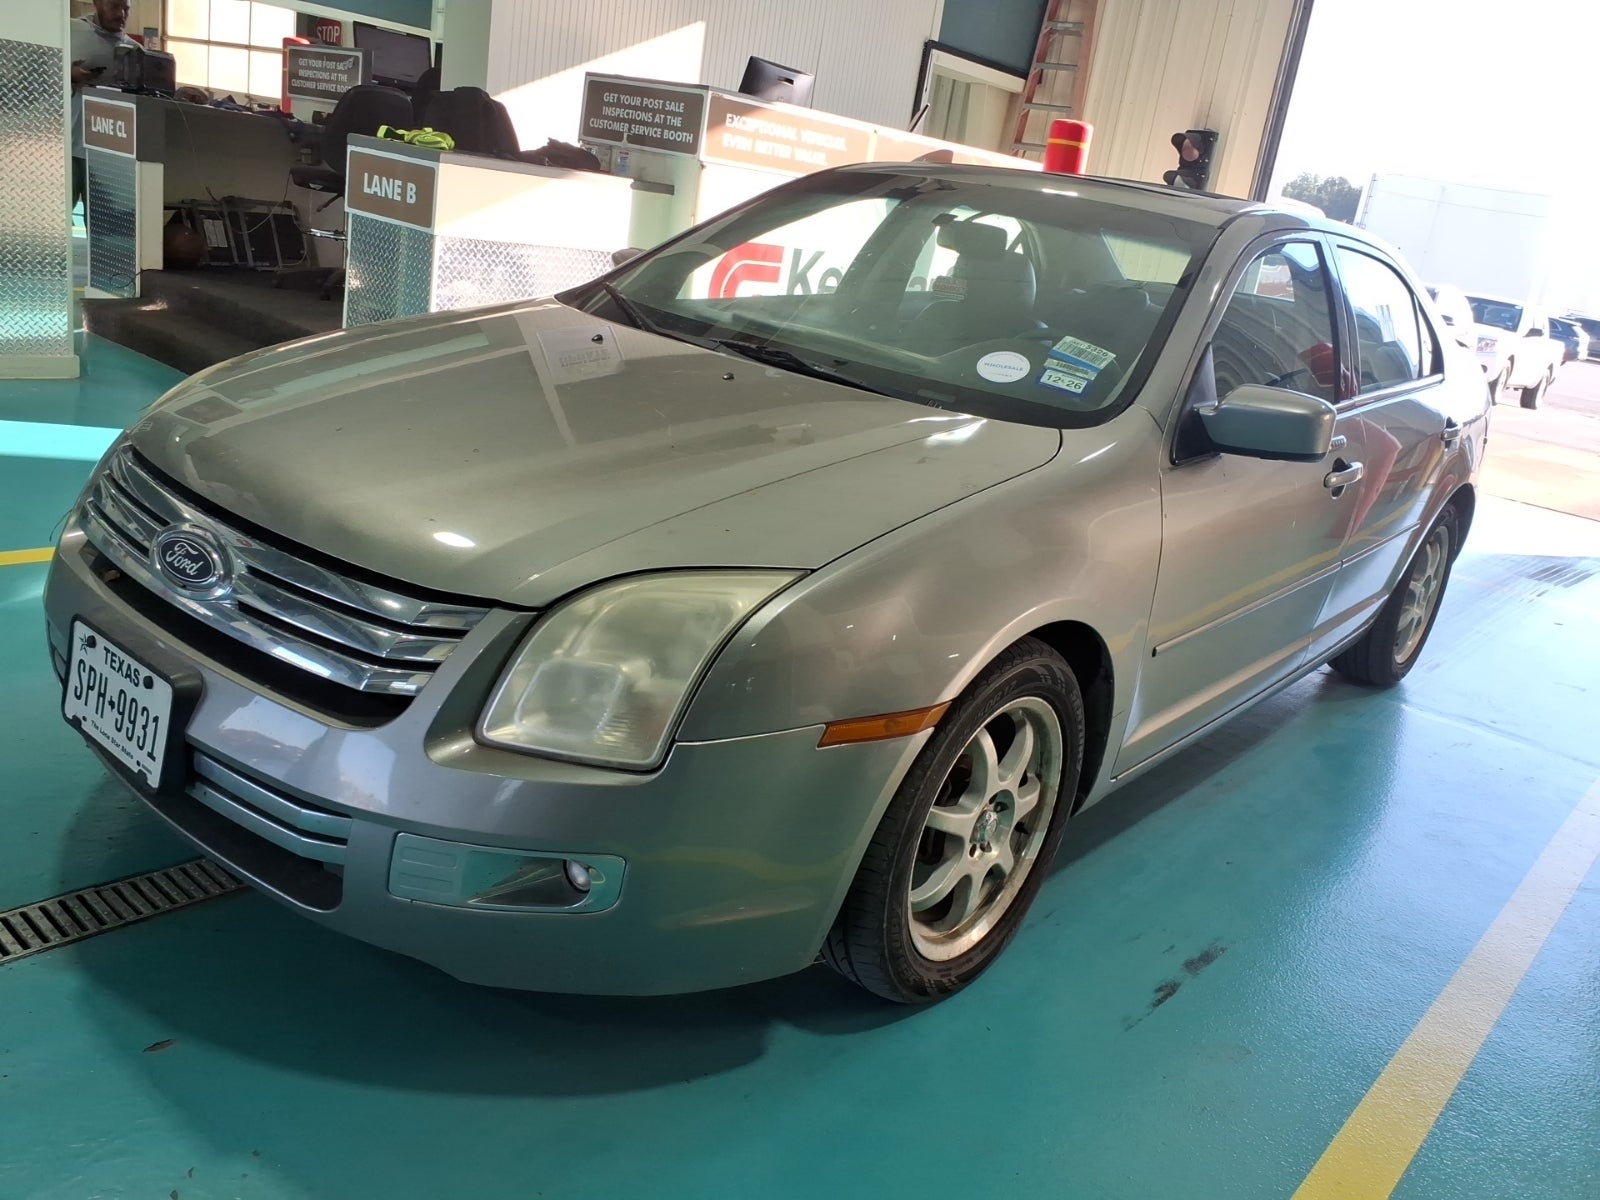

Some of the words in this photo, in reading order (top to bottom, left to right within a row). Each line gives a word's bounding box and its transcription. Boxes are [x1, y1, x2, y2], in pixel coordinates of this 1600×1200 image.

[316, 25, 340, 42] STOP
[299, 58, 308, 66] GET
[308, 58, 322, 67] YOUR
[291, 79, 316, 89] CUSTOMER
[316, 81, 336, 92] SERVICE
[337, 84, 351, 93] BOO
[299, 69, 330, 80] INSPECTIONS
[330, 72, 337, 80] AT
[338, 73, 348, 82] THE
[603, 92, 619, 102] GET
[619, 94, 641, 107] YOUR
[642, 97, 664, 110] POST
[664, 101, 685, 113] SALE
[91, 115, 114, 136] LANE
[116, 120, 127, 139] CL
[602, 106, 653, 122] INSPECTIONS
[653, 114, 665, 124] AT
[666, 115, 682, 127] THE
[589, 118, 629, 132] CUSTOMER
[630, 124, 662, 138] SERVICE
[663, 130, 693, 144] BOOTH
[363, 172, 402, 202] LANE
[406, 182, 417, 204] B
[983, 361, 1024, 373] WHOLESALE
[1046, 373, 1061, 385] 12
[1065, 380, 1082, 391] 26
[165, 541, 204, 576] Ford
[103, 645, 141, 688] TEXAS
[90, 719, 100, 733] The
[99, 728, 110, 742] Lone
[110, 736, 121, 750] Star
[120, 745, 134, 761] State
